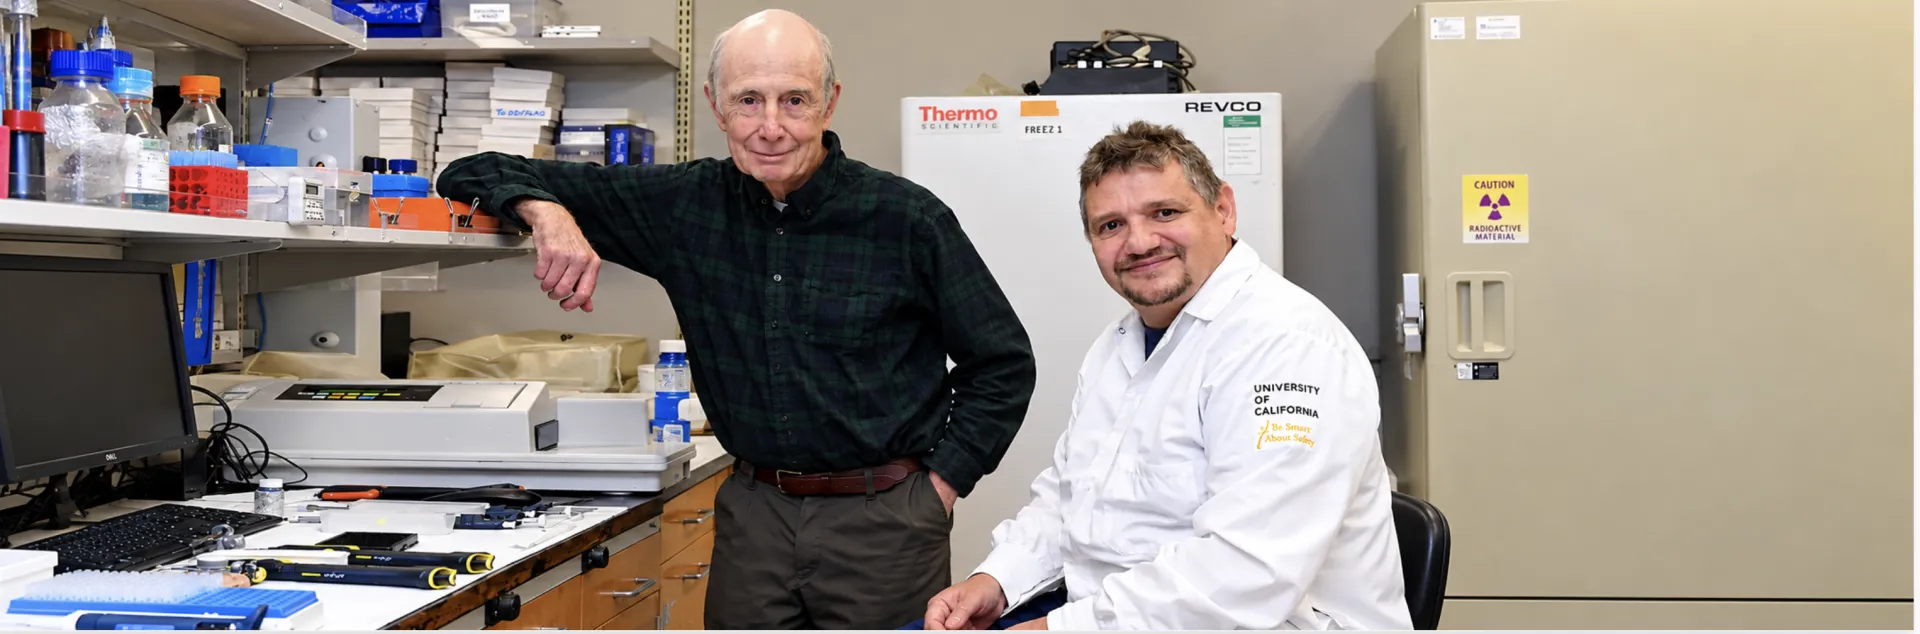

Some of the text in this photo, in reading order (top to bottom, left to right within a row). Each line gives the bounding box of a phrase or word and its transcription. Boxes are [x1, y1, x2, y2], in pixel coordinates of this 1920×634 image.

[1185, 101, 1262, 112] REVCO
[919, 106, 998, 121] Thermo
[1025, 125, 1062, 134] FREEZ 1
[1474, 180, 1514, 189] CAUTION
[1254, 383, 1320, 395] UNIVERSITY
[1254, 395, 1269, 404] OF
[1254, 405, 1319, 419] CALIFORNIA
[1271, 422, 1312, 433] Be Smart
[1264, 433, 1316, 448] About Safety
